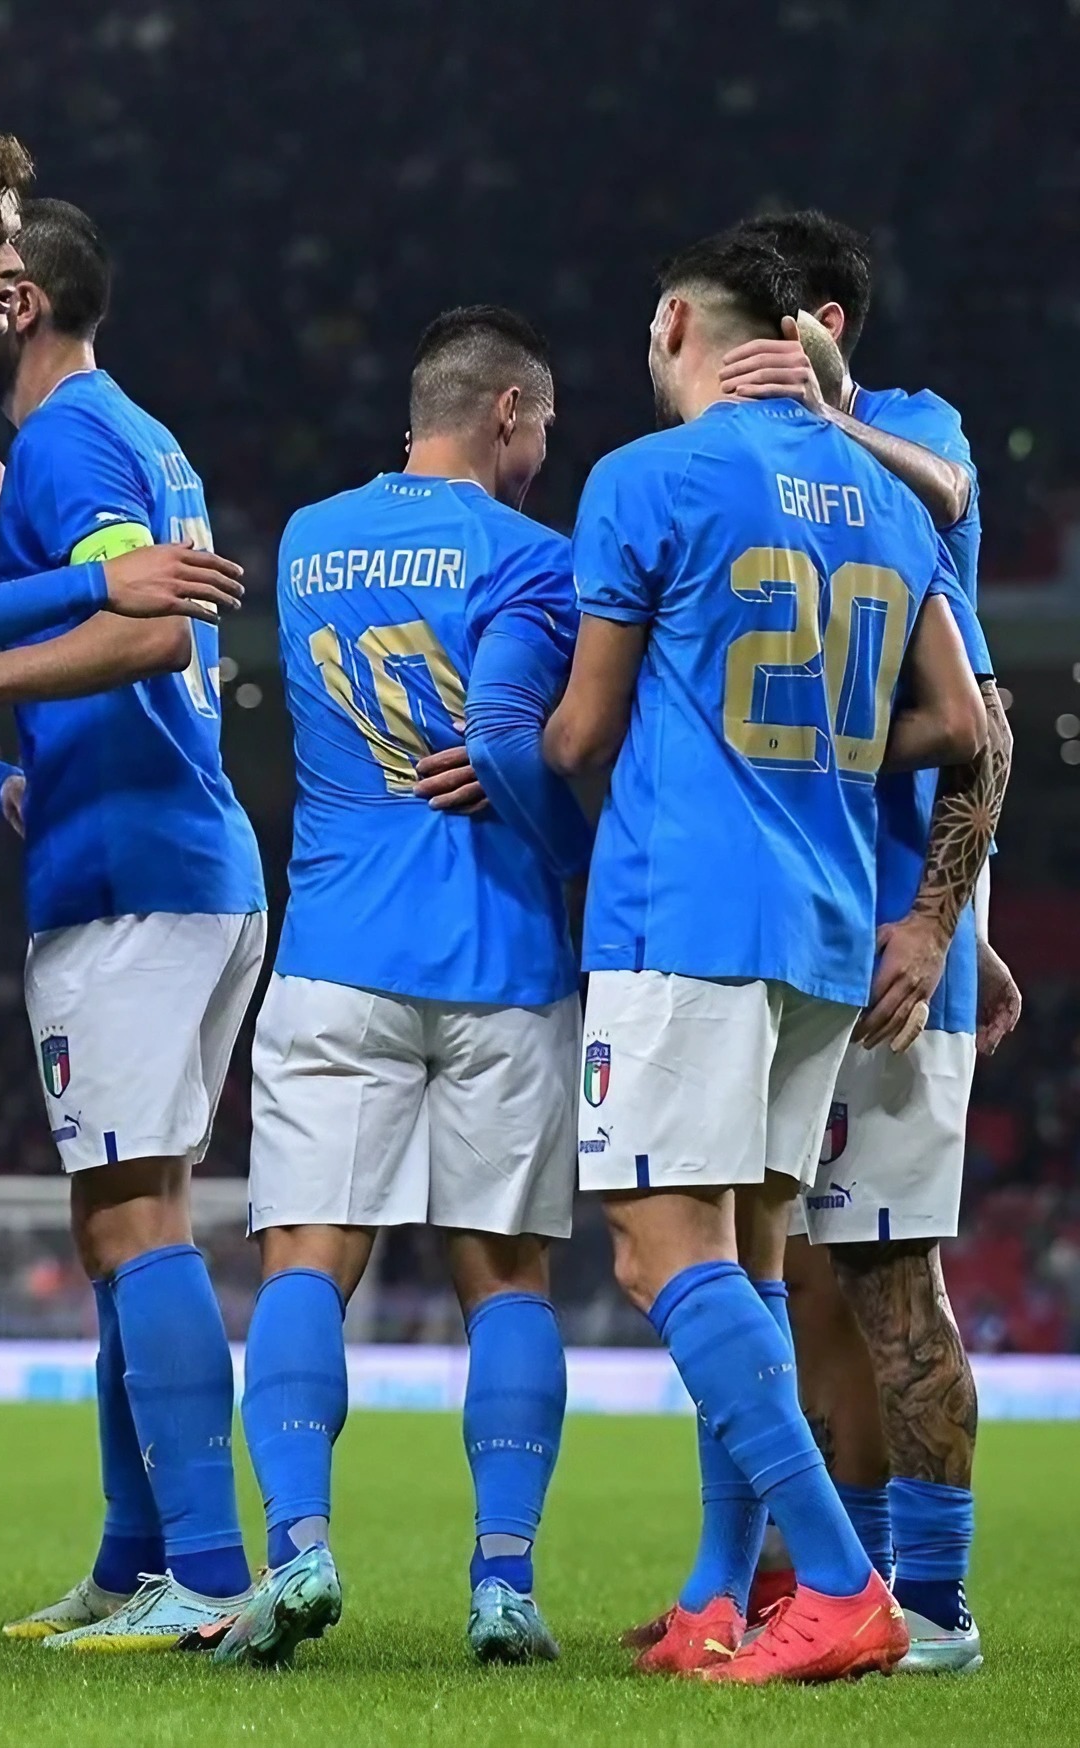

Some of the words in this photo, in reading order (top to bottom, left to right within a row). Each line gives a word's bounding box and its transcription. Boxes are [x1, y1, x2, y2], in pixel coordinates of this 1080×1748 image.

[384, 482, 432, 497] ITALIA
[776, 473, 865, 527] GRIFO
[290, 548, 468, 598] RASPADORI
[723, 547, 921, 787] 20
[308, 619, 469, 798] 10
